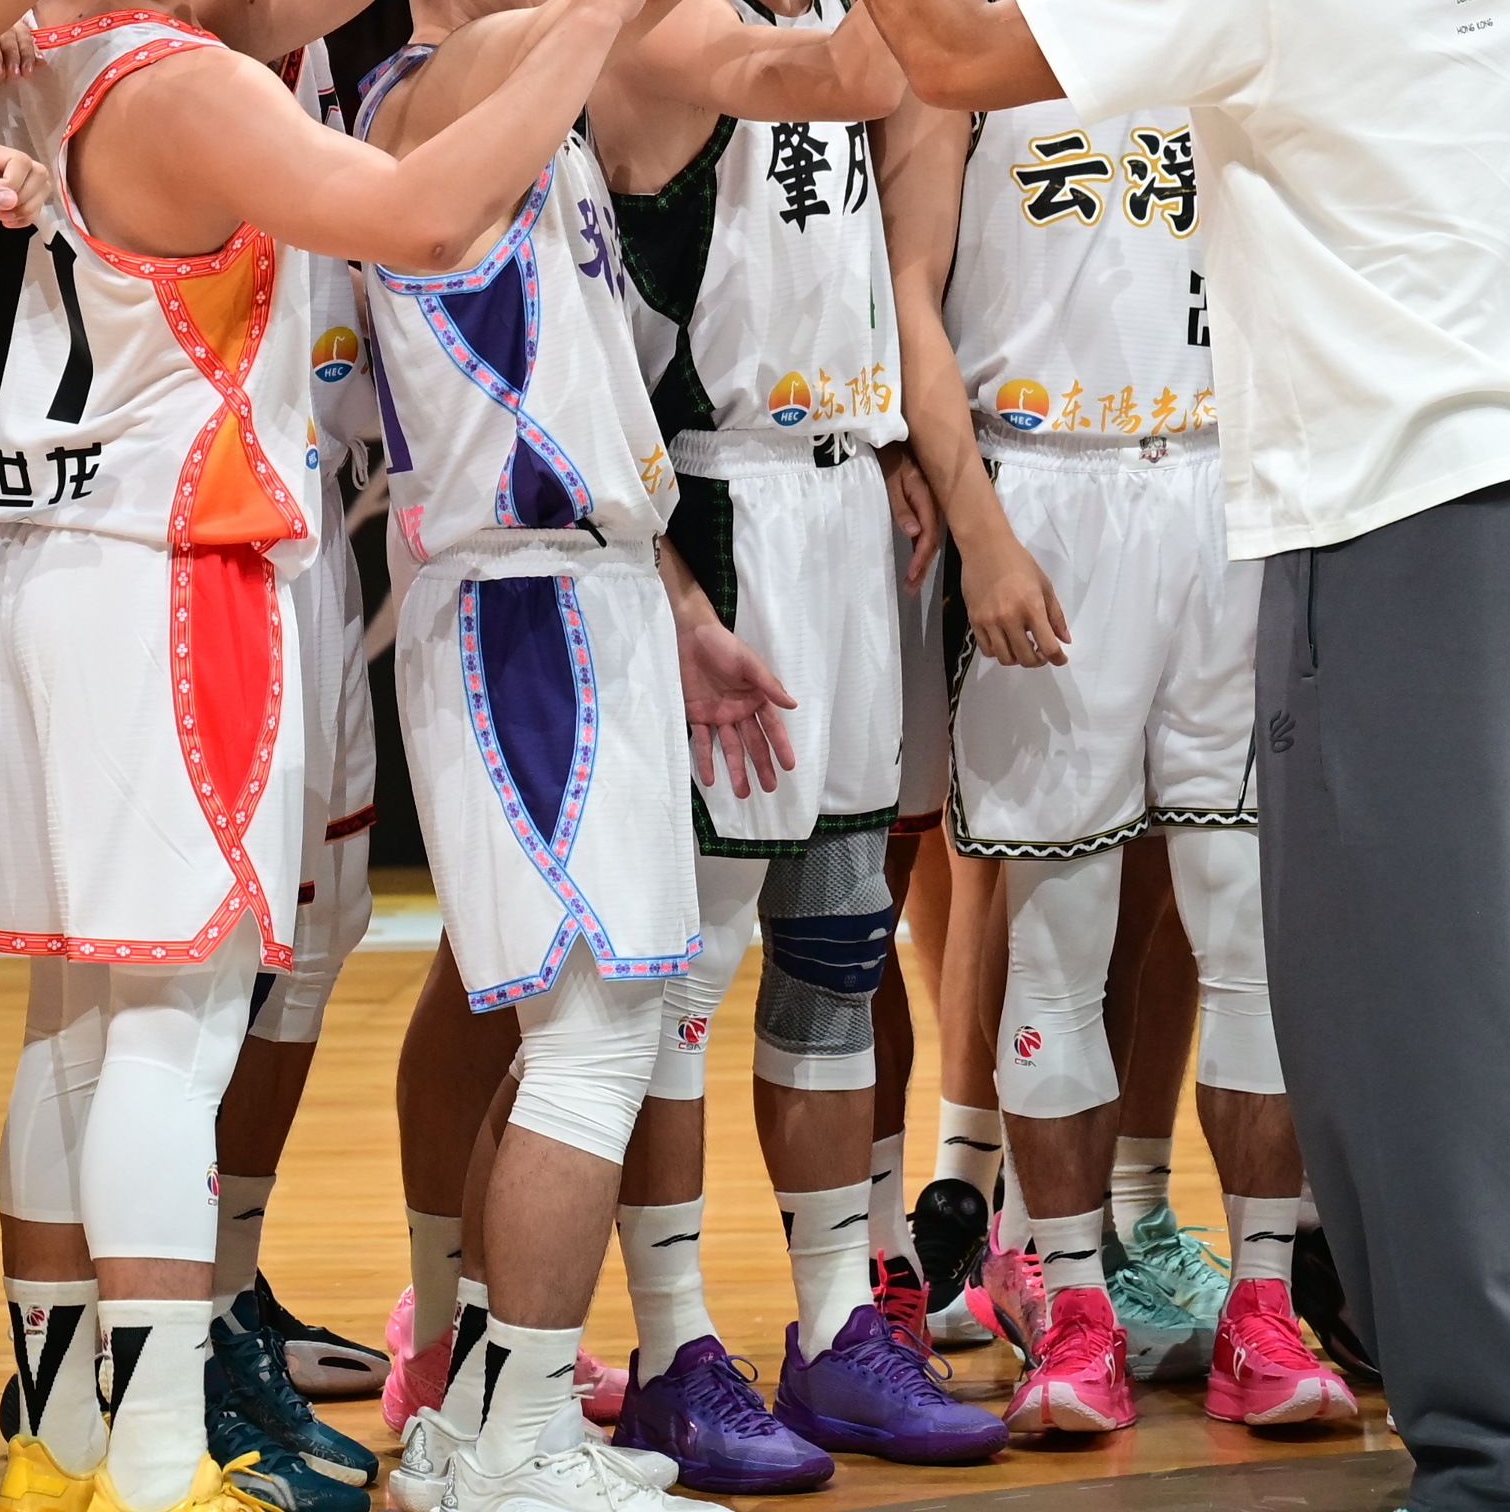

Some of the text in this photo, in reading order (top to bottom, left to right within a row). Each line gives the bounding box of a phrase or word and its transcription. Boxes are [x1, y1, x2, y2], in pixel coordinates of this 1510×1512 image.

[324, 366, 344, 377] HEC
[780, 411, 800, 423] HEC
[1009, 414, 1033, 427] HEC
